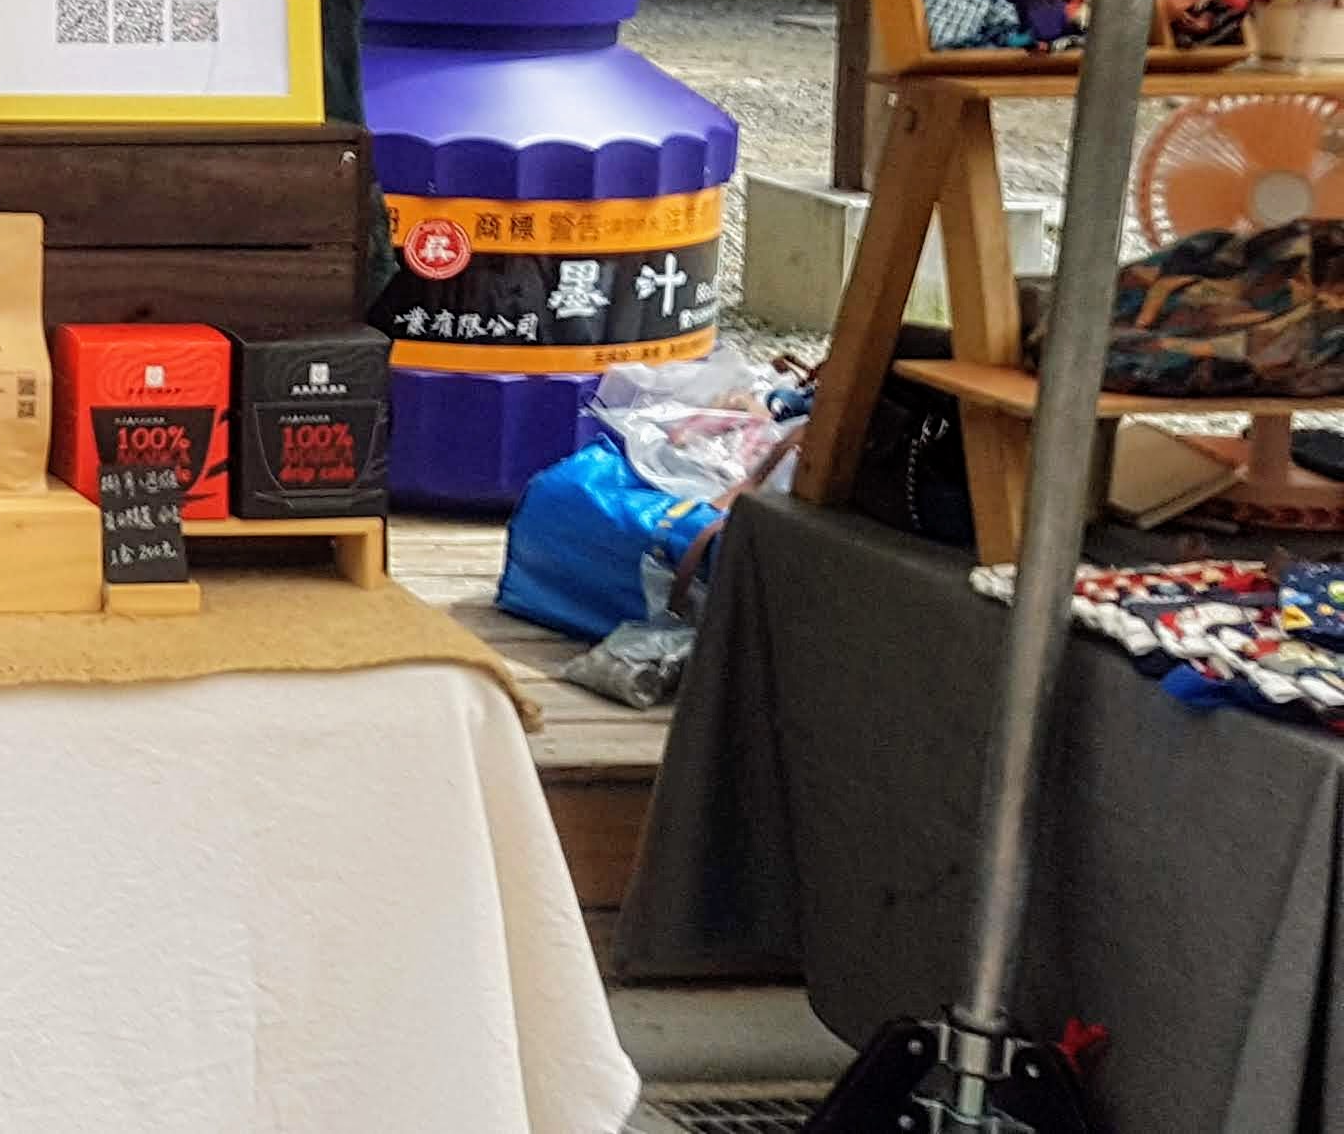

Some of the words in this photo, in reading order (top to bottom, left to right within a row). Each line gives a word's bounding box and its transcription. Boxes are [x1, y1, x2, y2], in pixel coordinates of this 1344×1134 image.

[546, 252, 688, 320] 墨汁
[117, 425, 193, 451] 100%
[282, 424, 354, 448] 100%
